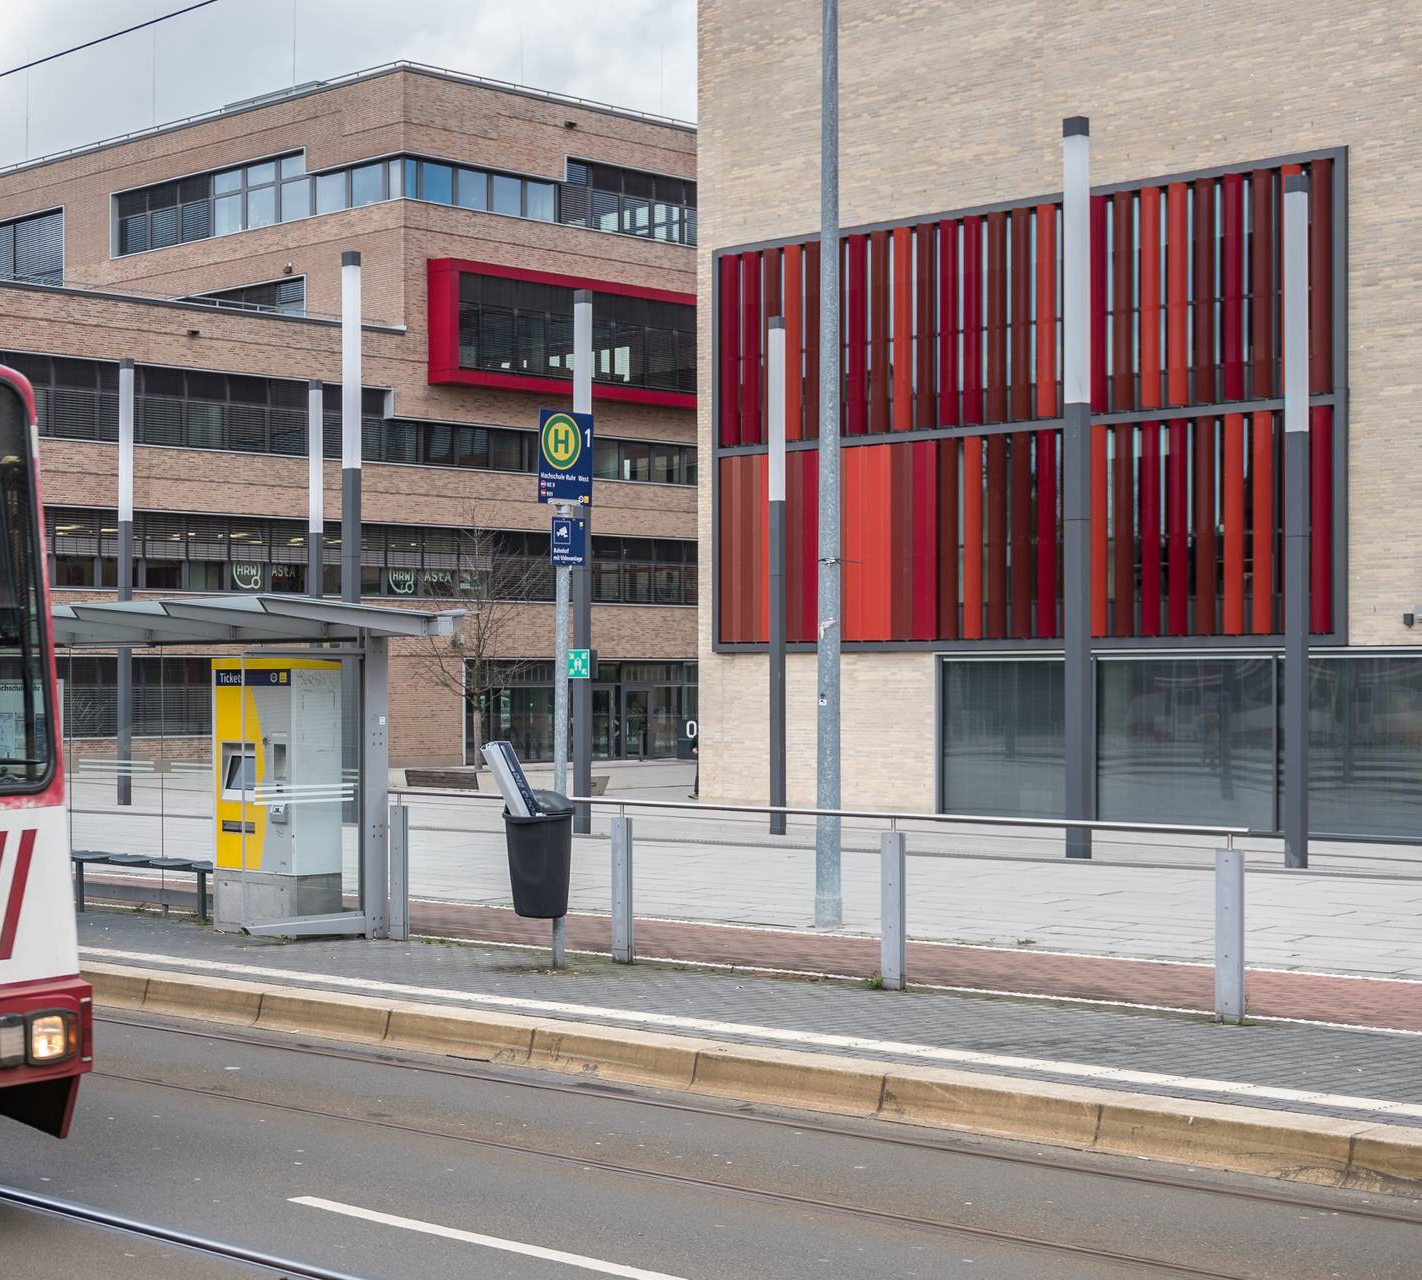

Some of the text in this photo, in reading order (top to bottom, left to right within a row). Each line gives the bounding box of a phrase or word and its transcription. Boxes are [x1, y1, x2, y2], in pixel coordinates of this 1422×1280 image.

[553, 428, 570, 454] H
[584, 428, 591, 448] 1
[540, 472, 565, 481] Hochschule
[578, 475, 590, 483] West
[237, 564, 258, 576] HRW
[392, 569, 411, 581] HRW
[220, 672, 242, 684] Ticket
